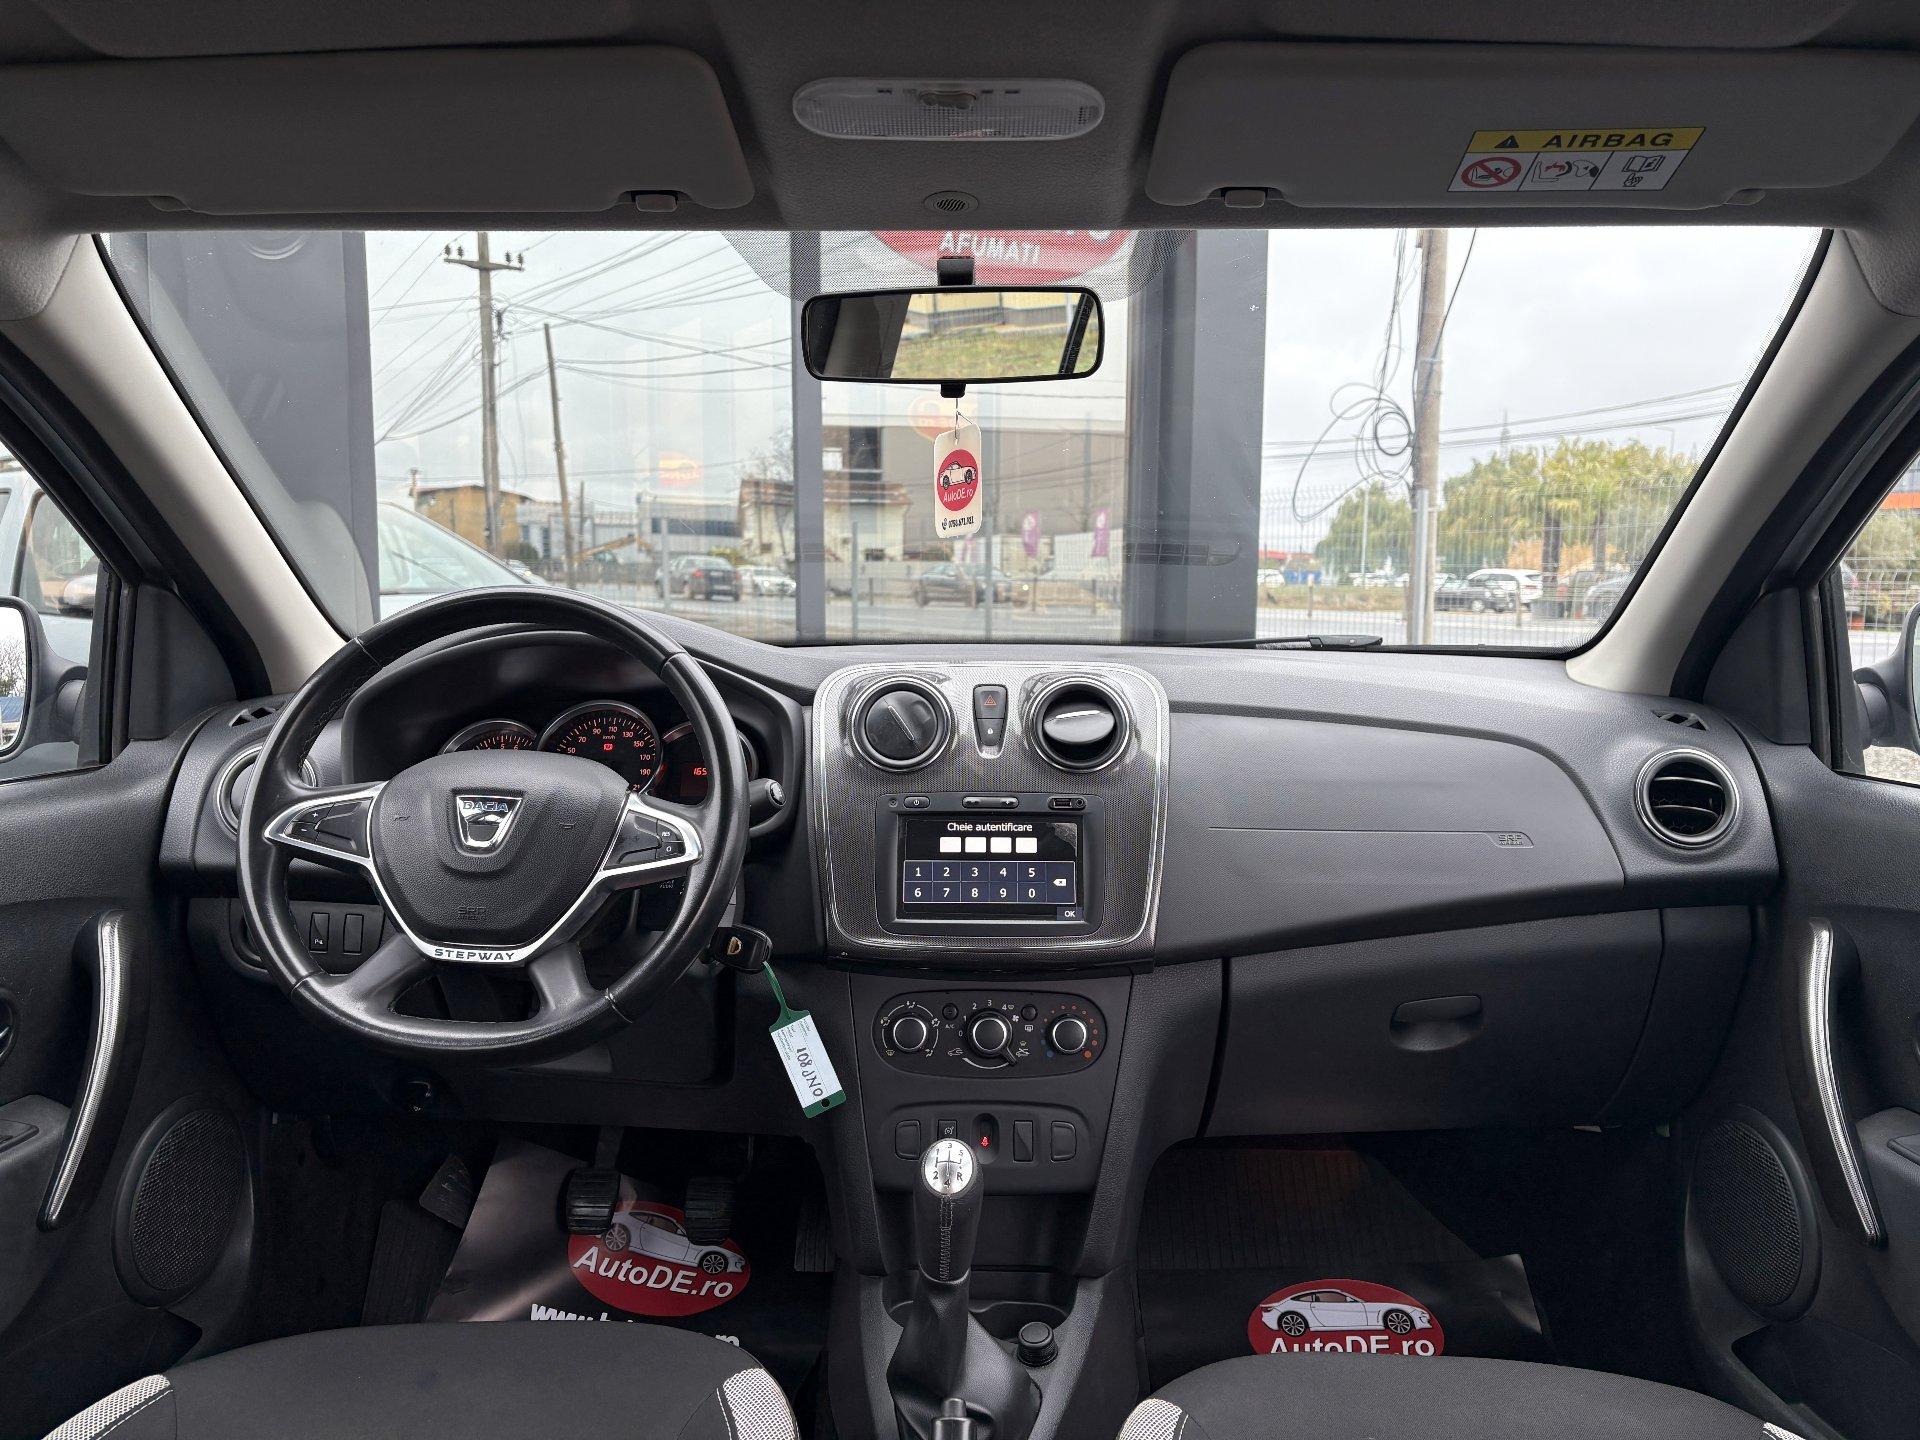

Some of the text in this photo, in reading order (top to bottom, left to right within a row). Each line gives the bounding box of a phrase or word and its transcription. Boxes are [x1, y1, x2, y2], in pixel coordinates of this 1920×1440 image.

[1542, 133, 1674, 148] AIRBAG
[939, 231, 1041, 262] AFUMATI
[633, 740, 645, 748] 150
[640, 753, 651, 761] 170
[462, 801, 509, 813] DACIA
[947, 822, 1033, 832] Cheie autentificare
[915, 867, 1036, 877] 1 2 3 4 5
[914, 887, 1036, 898] 6 7 8 9 0
[434, 948, 515, 961] STEPWAY
[972, 1002, 977, 1010] 2
[987, 999, 992, 1007] 3
[933, 1170, 939, 1180] 2
[956, 1171, 963, 1182] R
[943, 1178, 951, 1189] 4
[573, 1246, 733, 1298] AutoDE.ro
